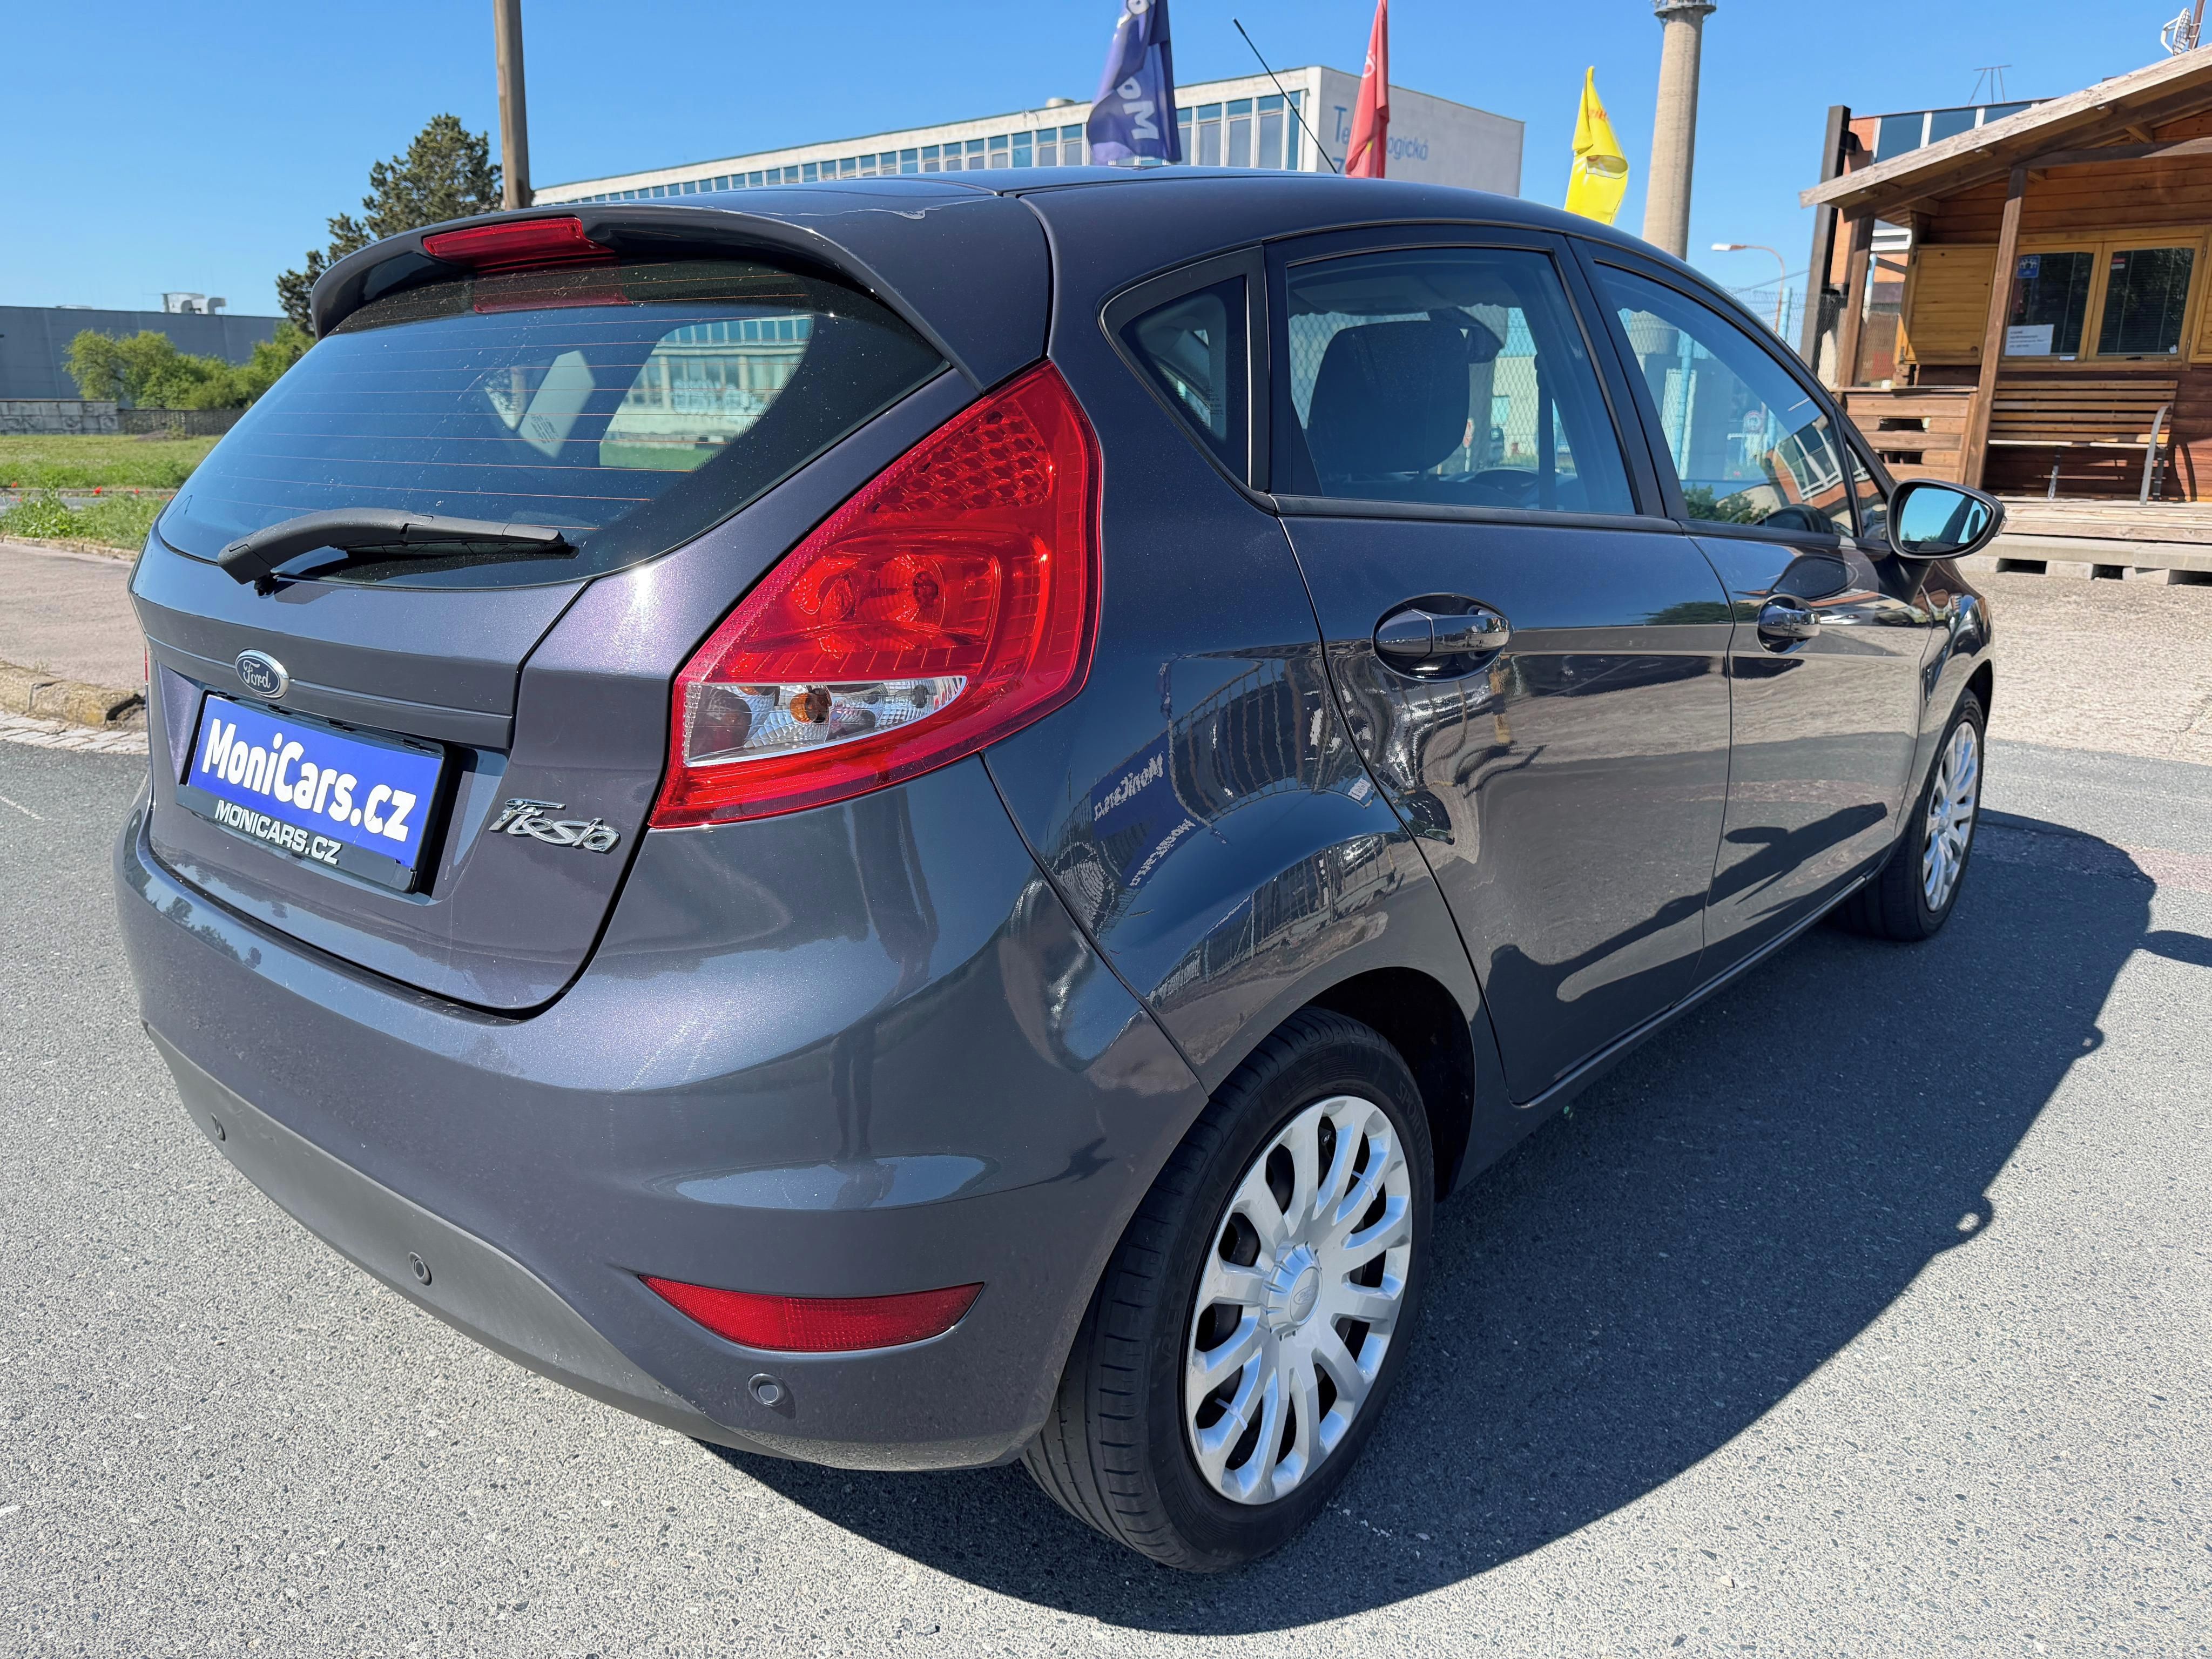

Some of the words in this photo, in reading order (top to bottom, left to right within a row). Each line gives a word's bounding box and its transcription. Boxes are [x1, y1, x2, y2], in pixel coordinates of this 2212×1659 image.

[242, 659, 271, 689] Ford
[201, 718, 417, 842] MoniCars.cz
[214, 800, 343, 865] MONICARS.CZ
[488, 798, 621, 852] Fiesta
